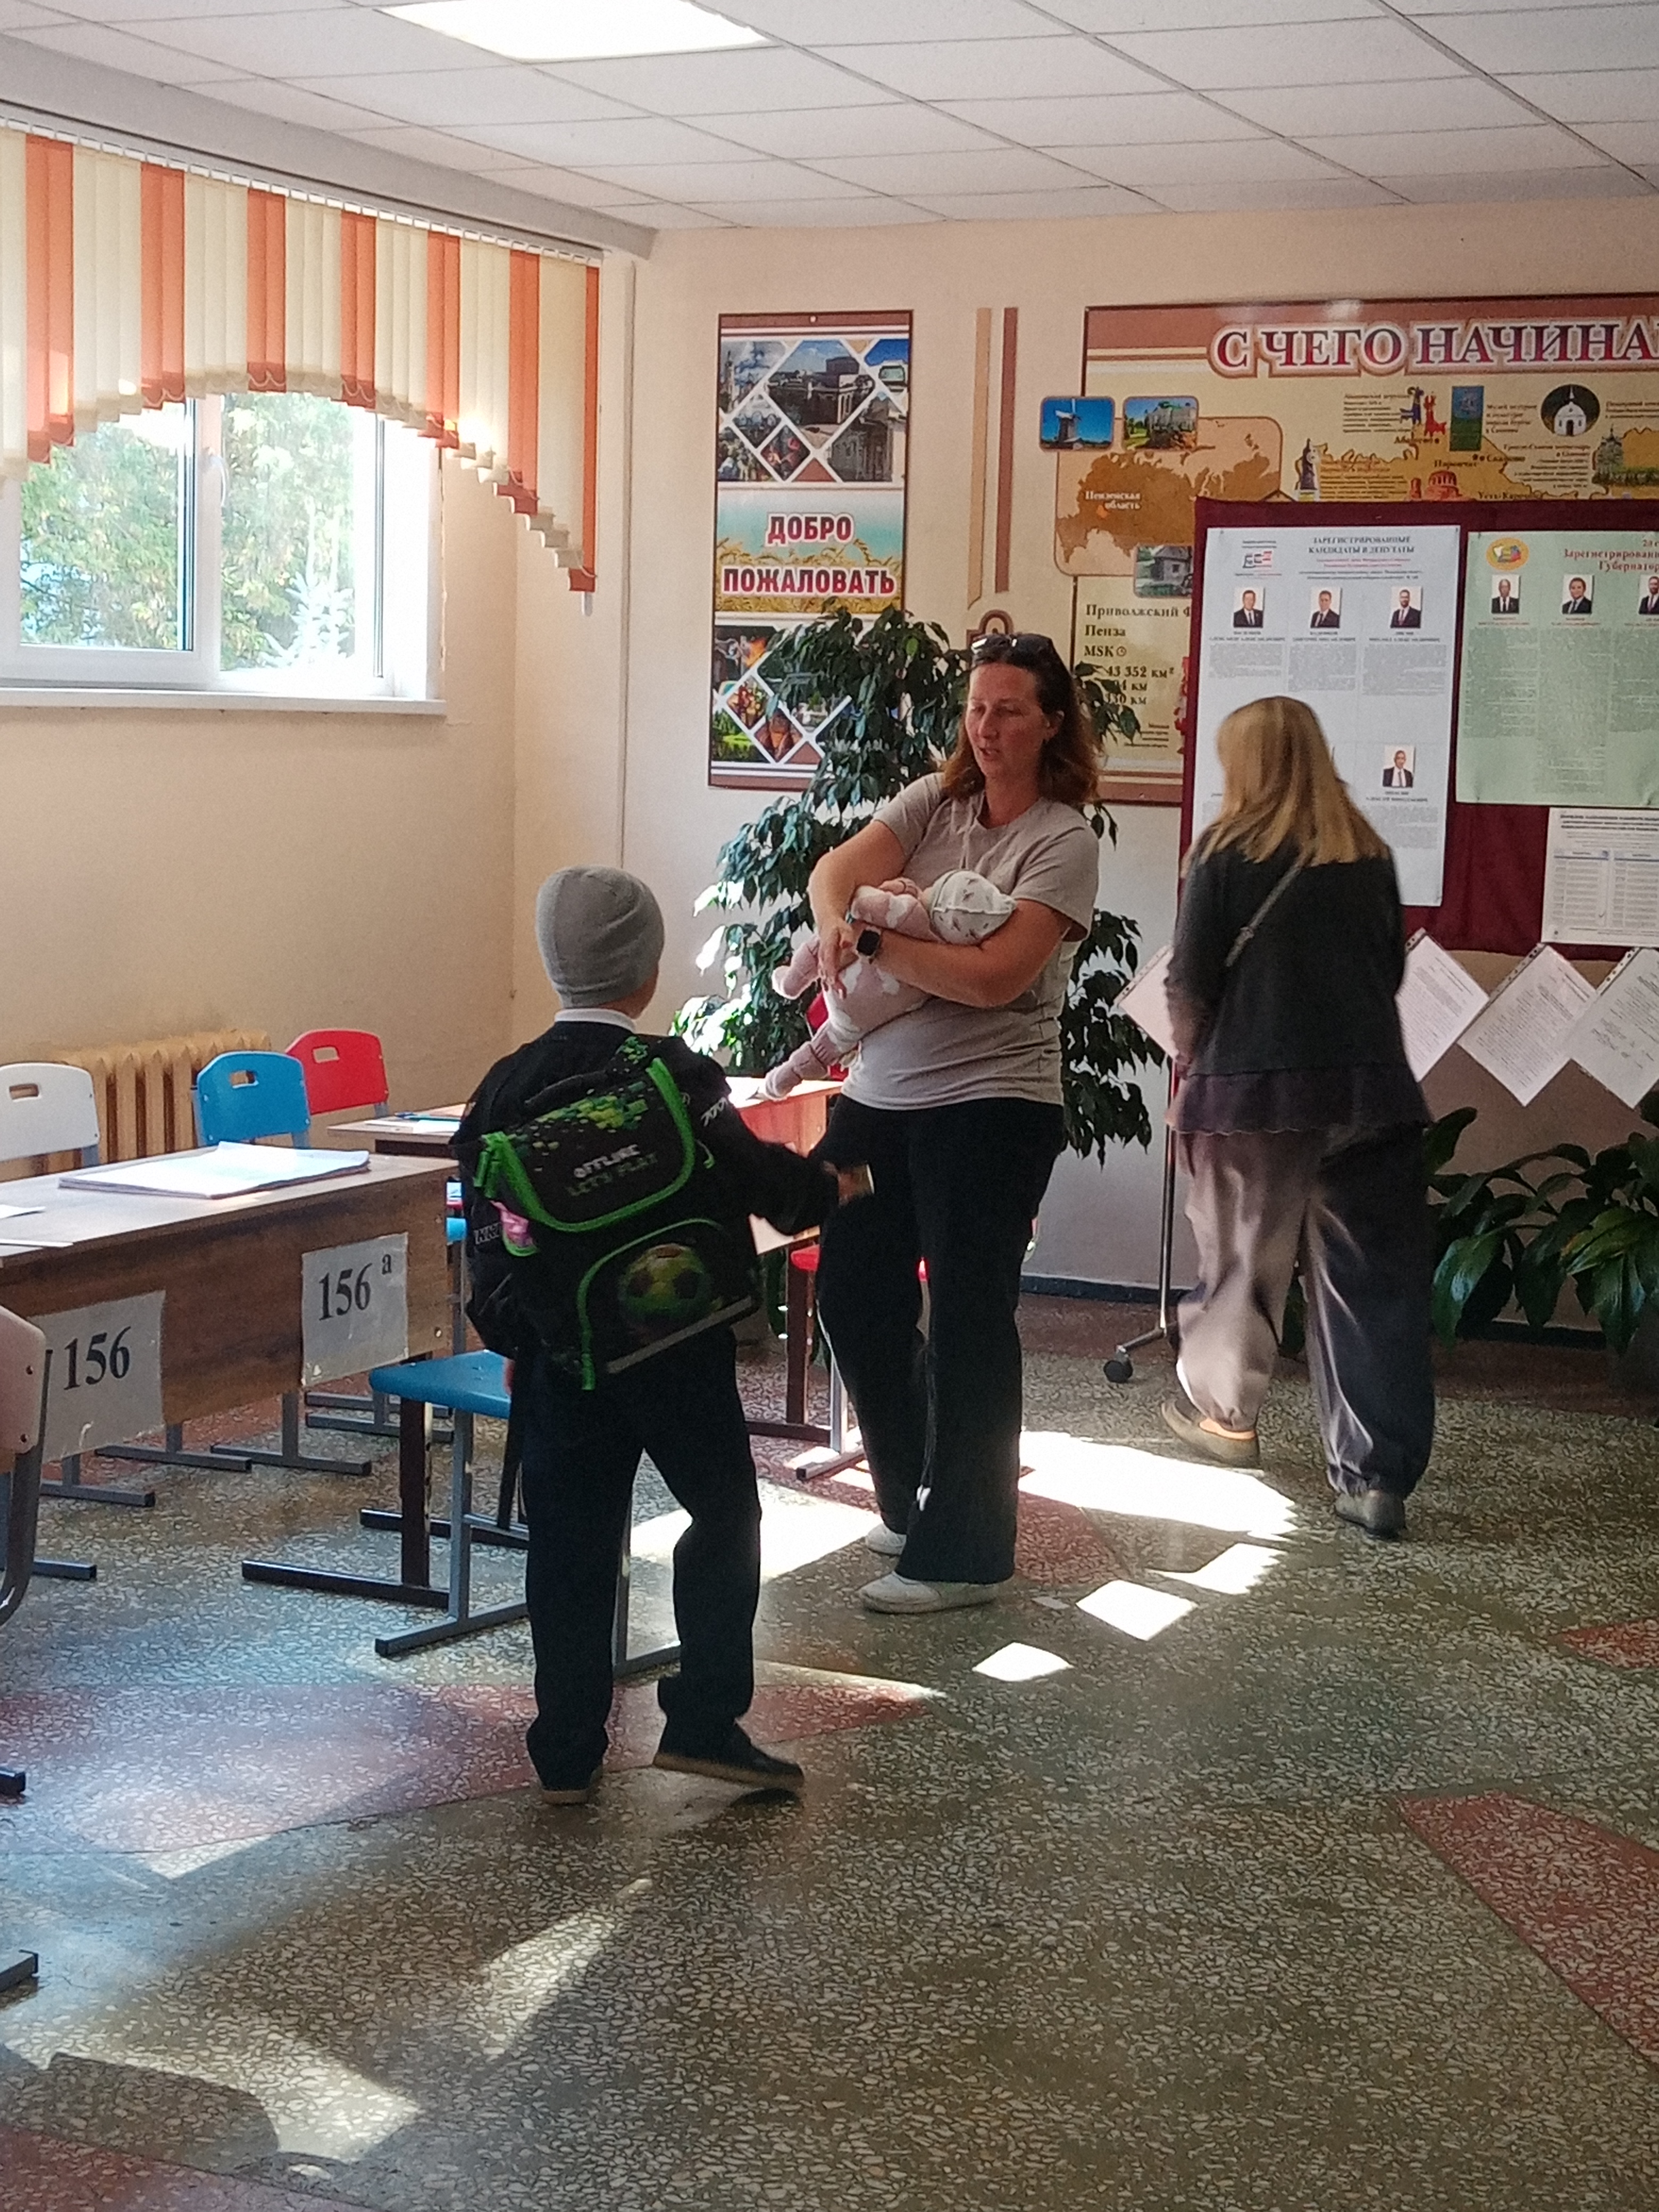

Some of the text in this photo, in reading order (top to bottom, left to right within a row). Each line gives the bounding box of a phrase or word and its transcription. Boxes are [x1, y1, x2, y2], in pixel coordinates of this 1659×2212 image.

[1218, 323, 1659, 367] С ЧЕГО НАЧИНА
[767, 515, 852, 544] ДОБРО
[723, 568, 895, 594] ПОЖАЛОВАТЬ
[1085, 604, 1179, 619] Приволжский
[1084, 625, 1126, 636] Пенза
[1084, 646, 1113, 657] MSK
[1125, 666, 1147, 677] 352
[1130, 697, 1146, 705] км
[317, 1263, 373, 1321] 156
[63, 1326, 132, 1390] 156
